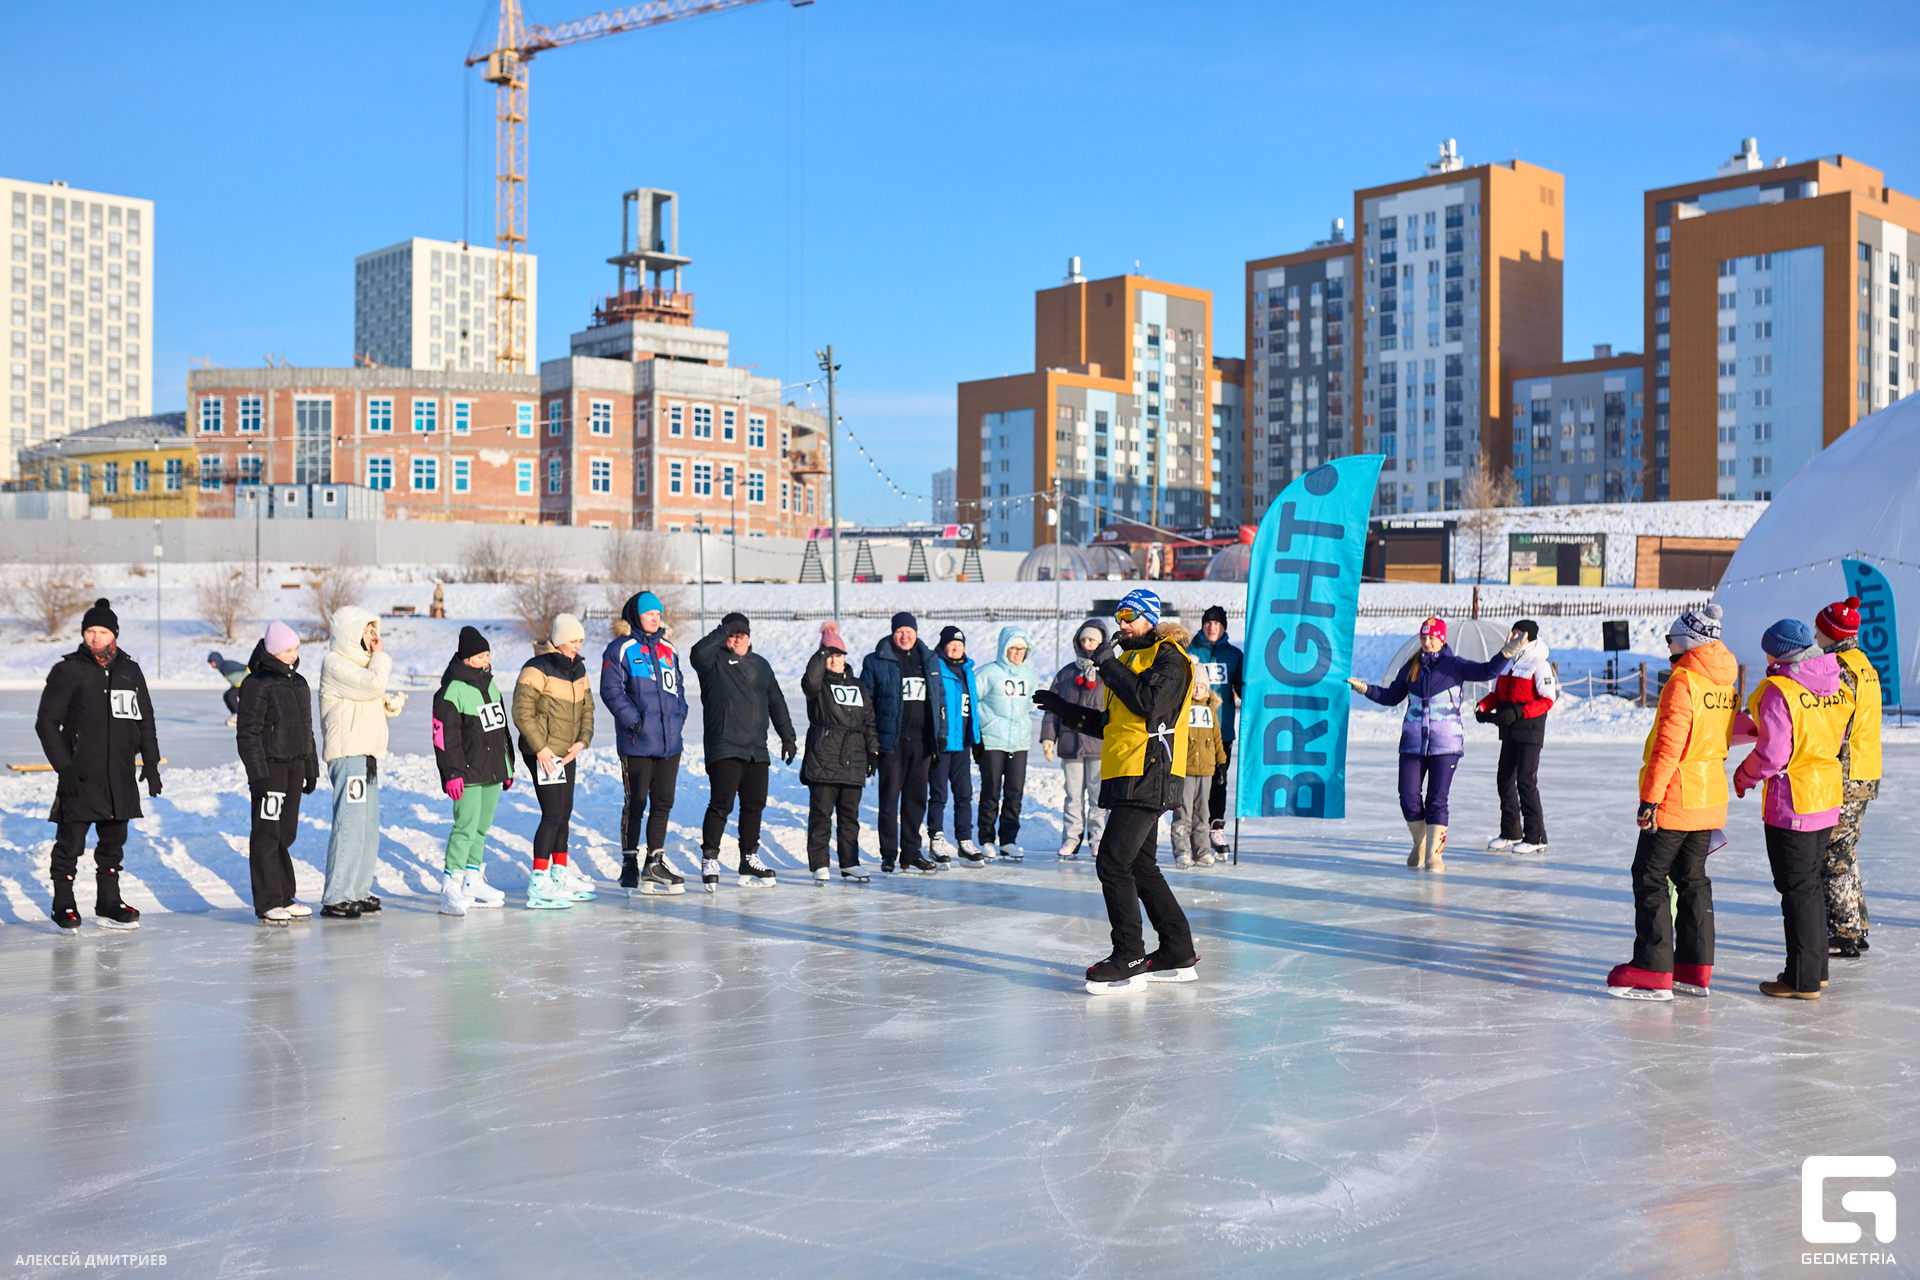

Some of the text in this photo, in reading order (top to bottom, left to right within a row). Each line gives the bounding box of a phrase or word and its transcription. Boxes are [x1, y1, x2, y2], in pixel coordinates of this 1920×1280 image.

[1262, 501, 1345, 817] BRIGHT
[833, 687, 858, 703] 07
[902, 679, 925, 698] 47
[1004, 680, 1027, 697] 01
[113, 693, 138, 716] 16
[480, 705, 505, 729] 15
